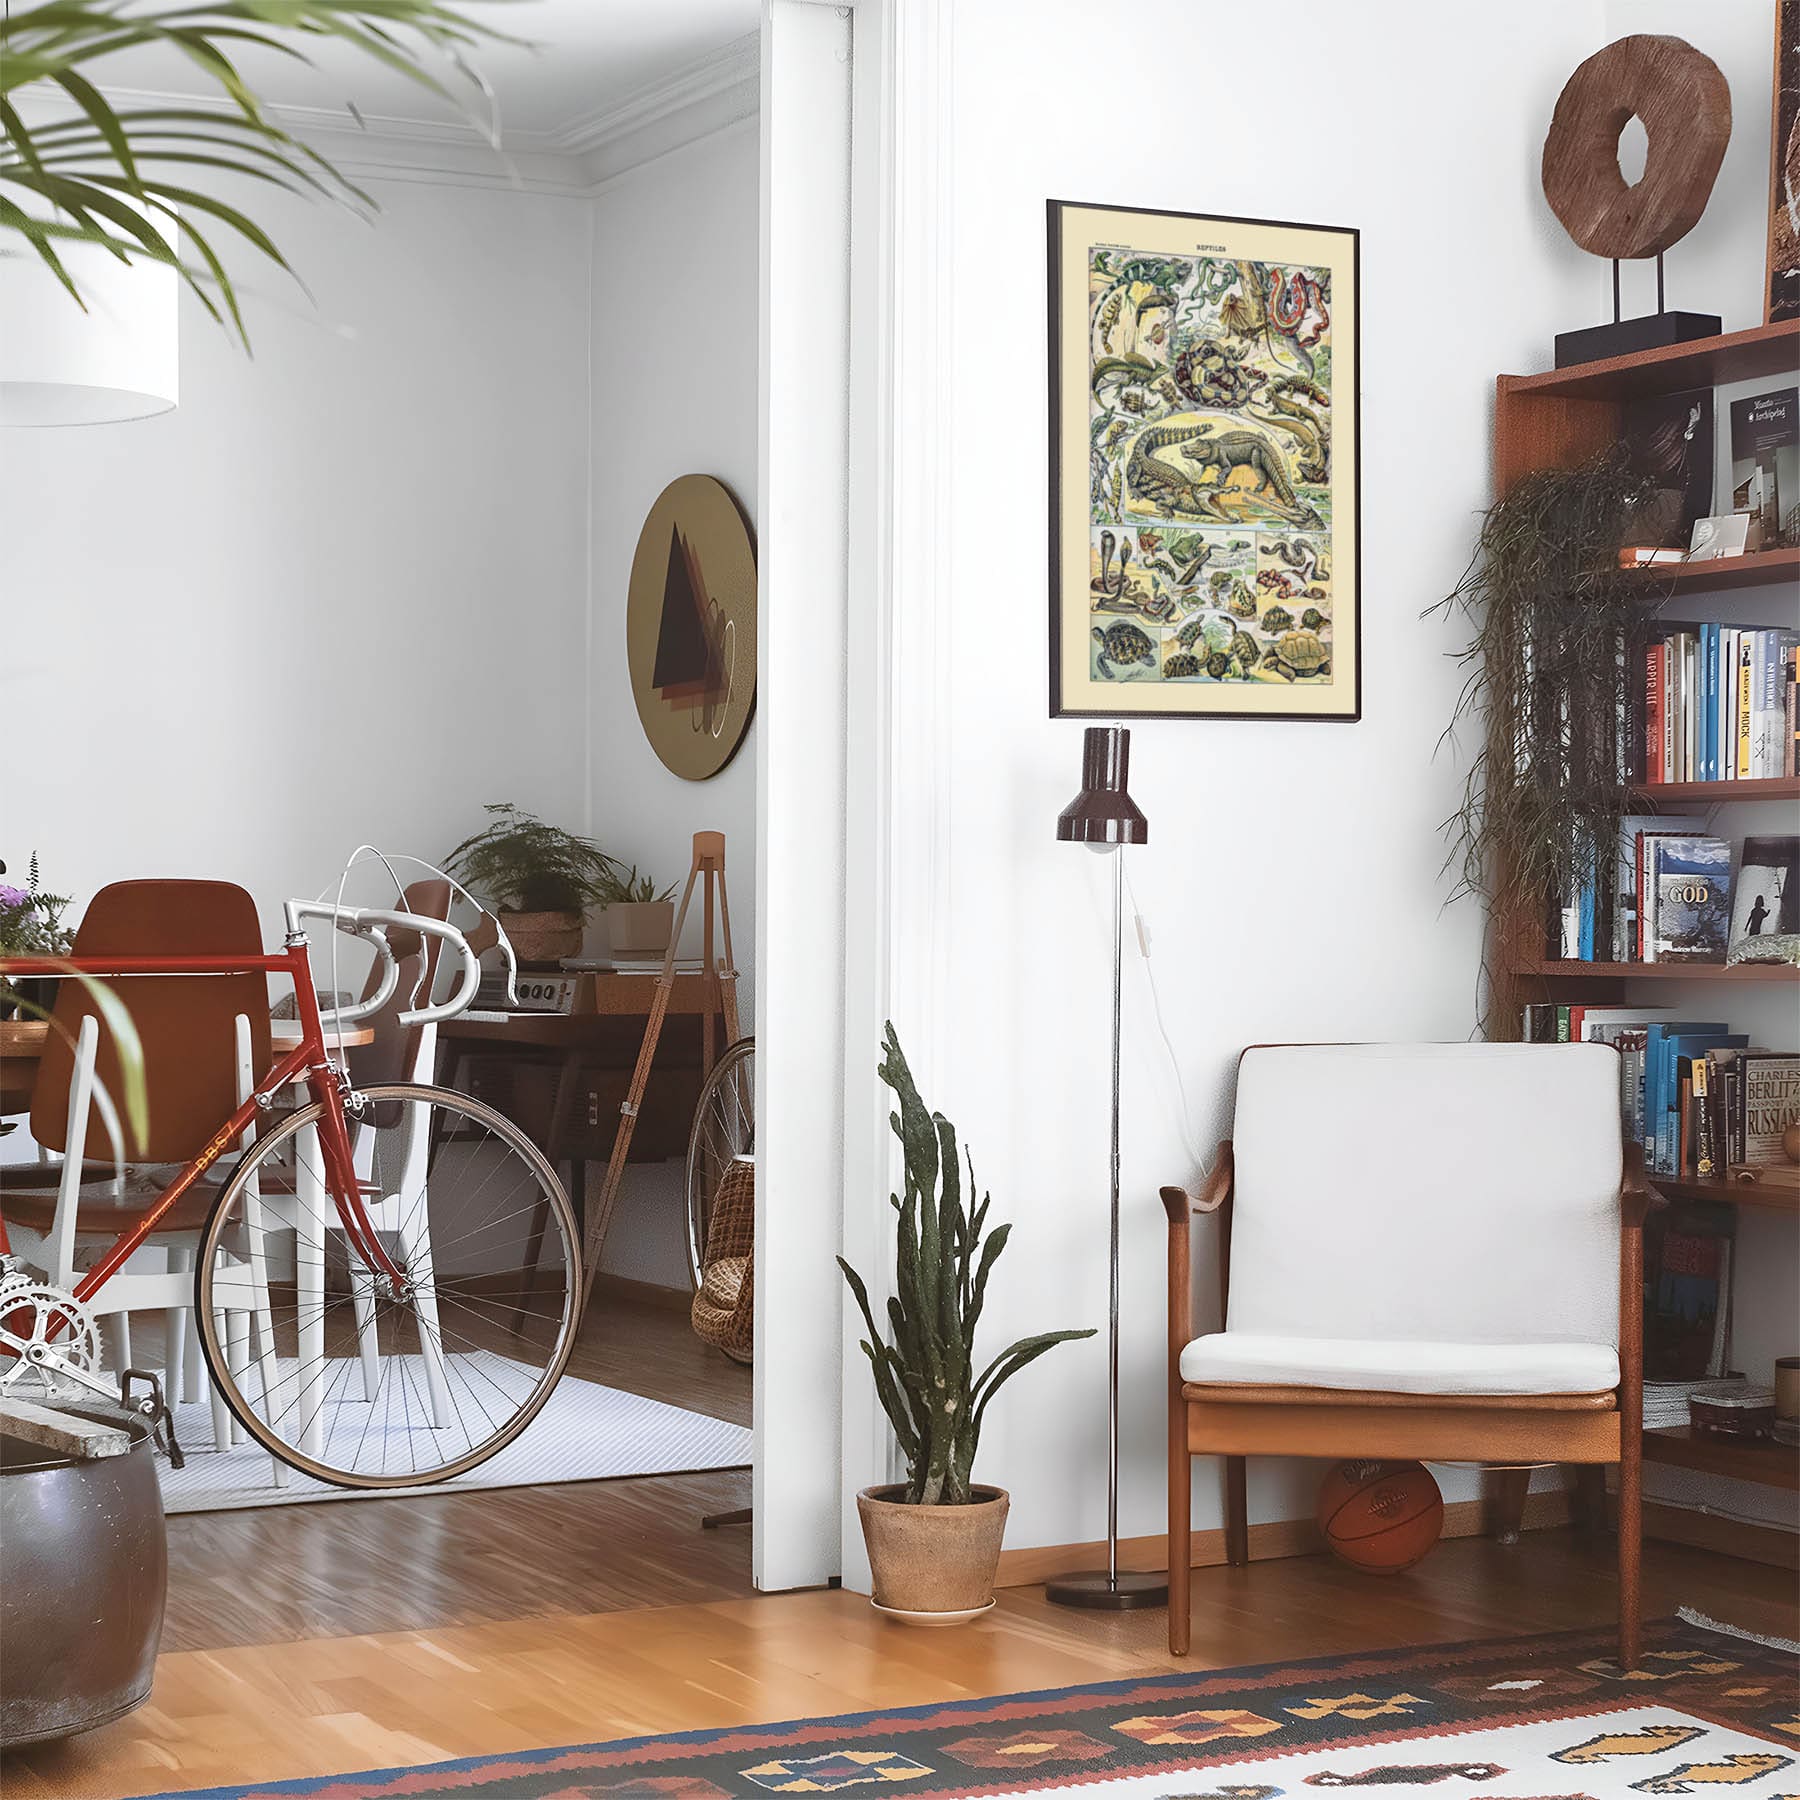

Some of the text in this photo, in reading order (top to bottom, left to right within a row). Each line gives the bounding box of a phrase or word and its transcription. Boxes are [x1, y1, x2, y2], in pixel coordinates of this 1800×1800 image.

[1646, 652, 1657, 704] HARPER LEE
[1741, 711, 1750, 738] MOCK
[1669, 886, 1708, 904] GOD
[1748, 1071, 1800, 1081] CHARLES
[1748, 1081, 1799, 1099] BERLITZ
[1748, 1100, 1784, 1108] PASSPORT
[195, 1136, 228, 1171] DBS
